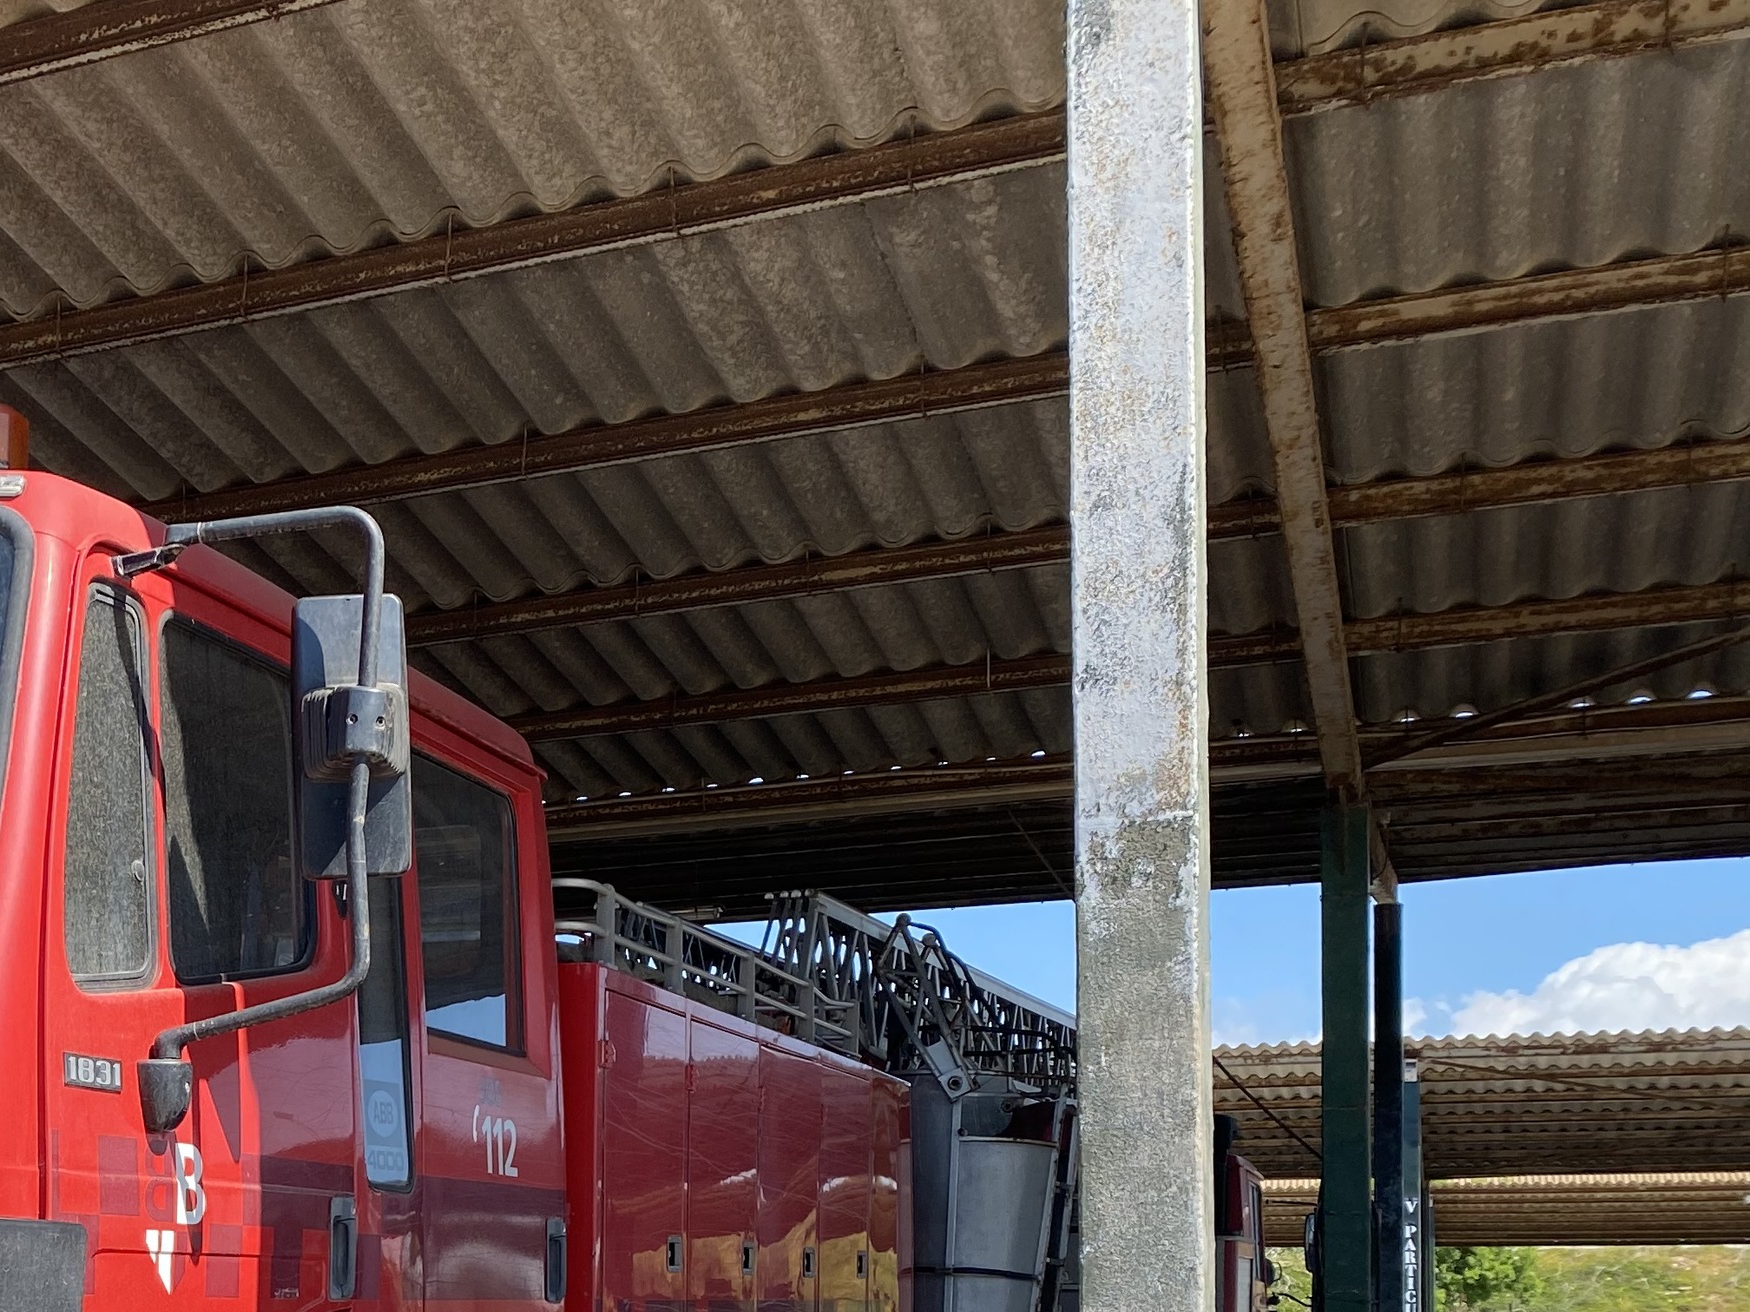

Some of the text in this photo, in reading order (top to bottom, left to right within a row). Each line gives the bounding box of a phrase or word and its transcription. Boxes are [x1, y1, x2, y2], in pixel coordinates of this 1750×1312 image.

[67, 1055, 122, 1087] 1831
[373, 1102, 394, 1125] ABB
[481, 1115, 519, 1178] 112
[367, 1151, 405, 1172] 4000
